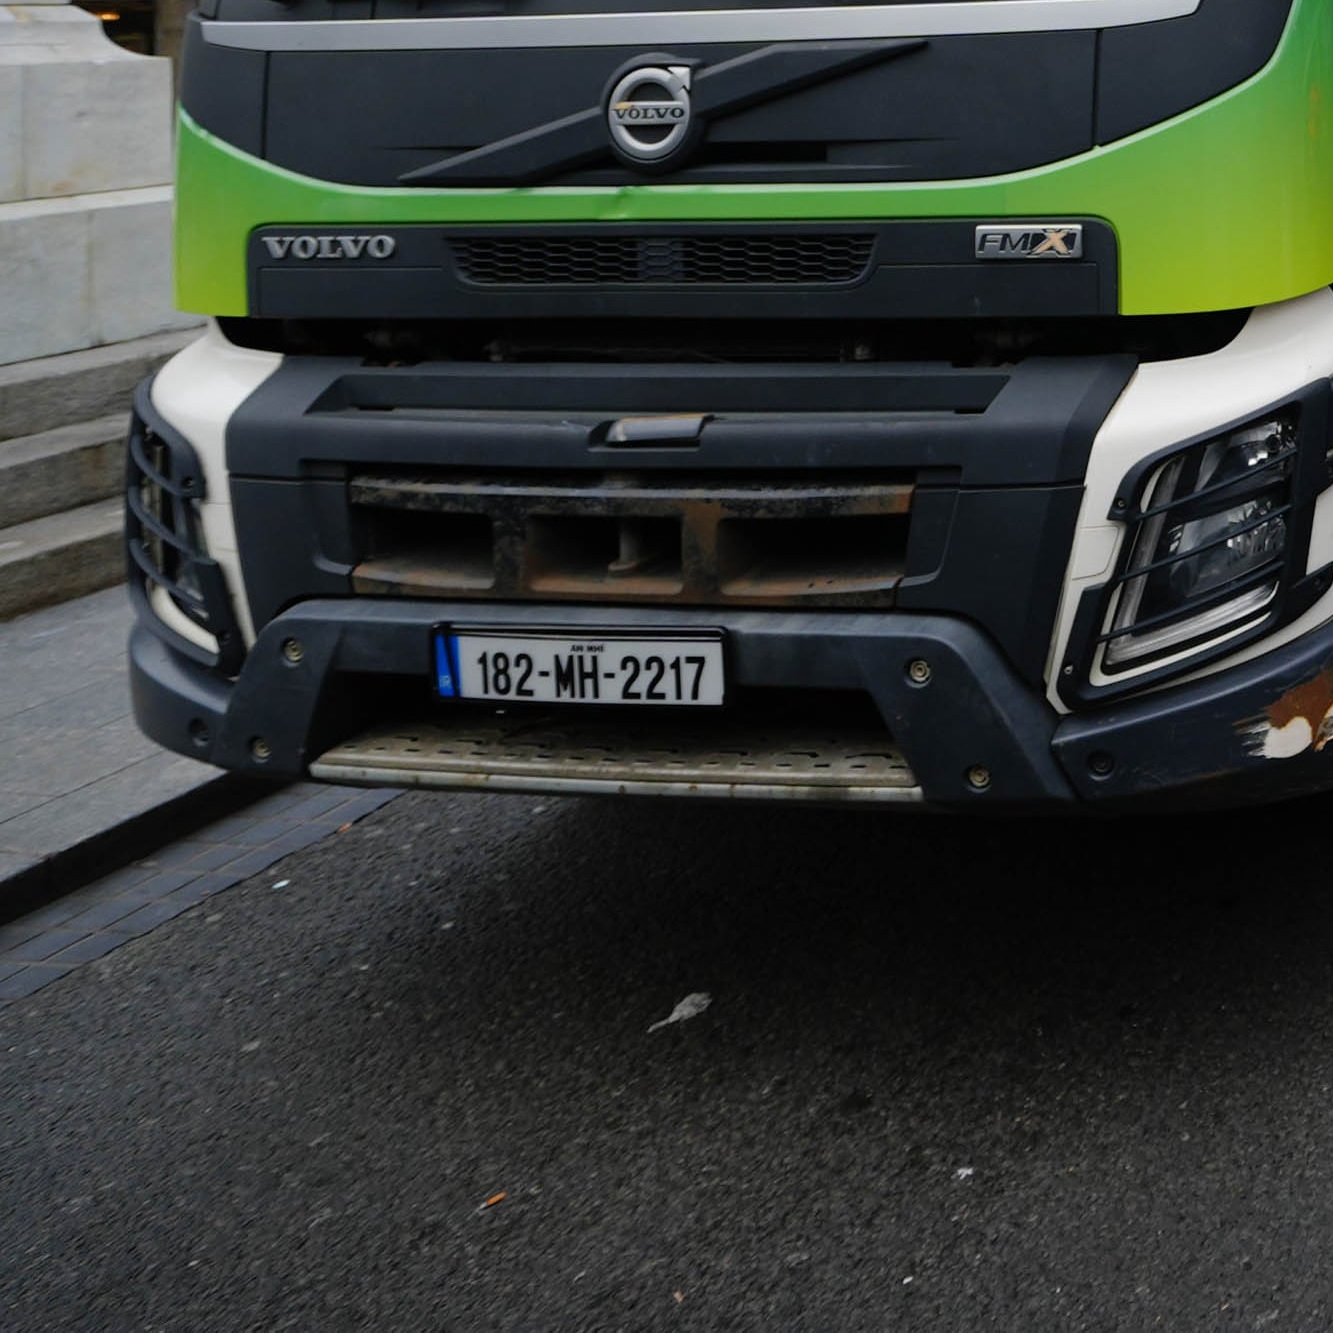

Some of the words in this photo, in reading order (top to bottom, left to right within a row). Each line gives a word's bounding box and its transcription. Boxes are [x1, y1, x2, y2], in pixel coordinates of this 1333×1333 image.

[612, 107, 685, 120] VOLVO
[261, 234, 396, 259] VOLVO
[977, 227, 1077, 256] FMX
[478, 651, 706, 701] 182-MH-2217
